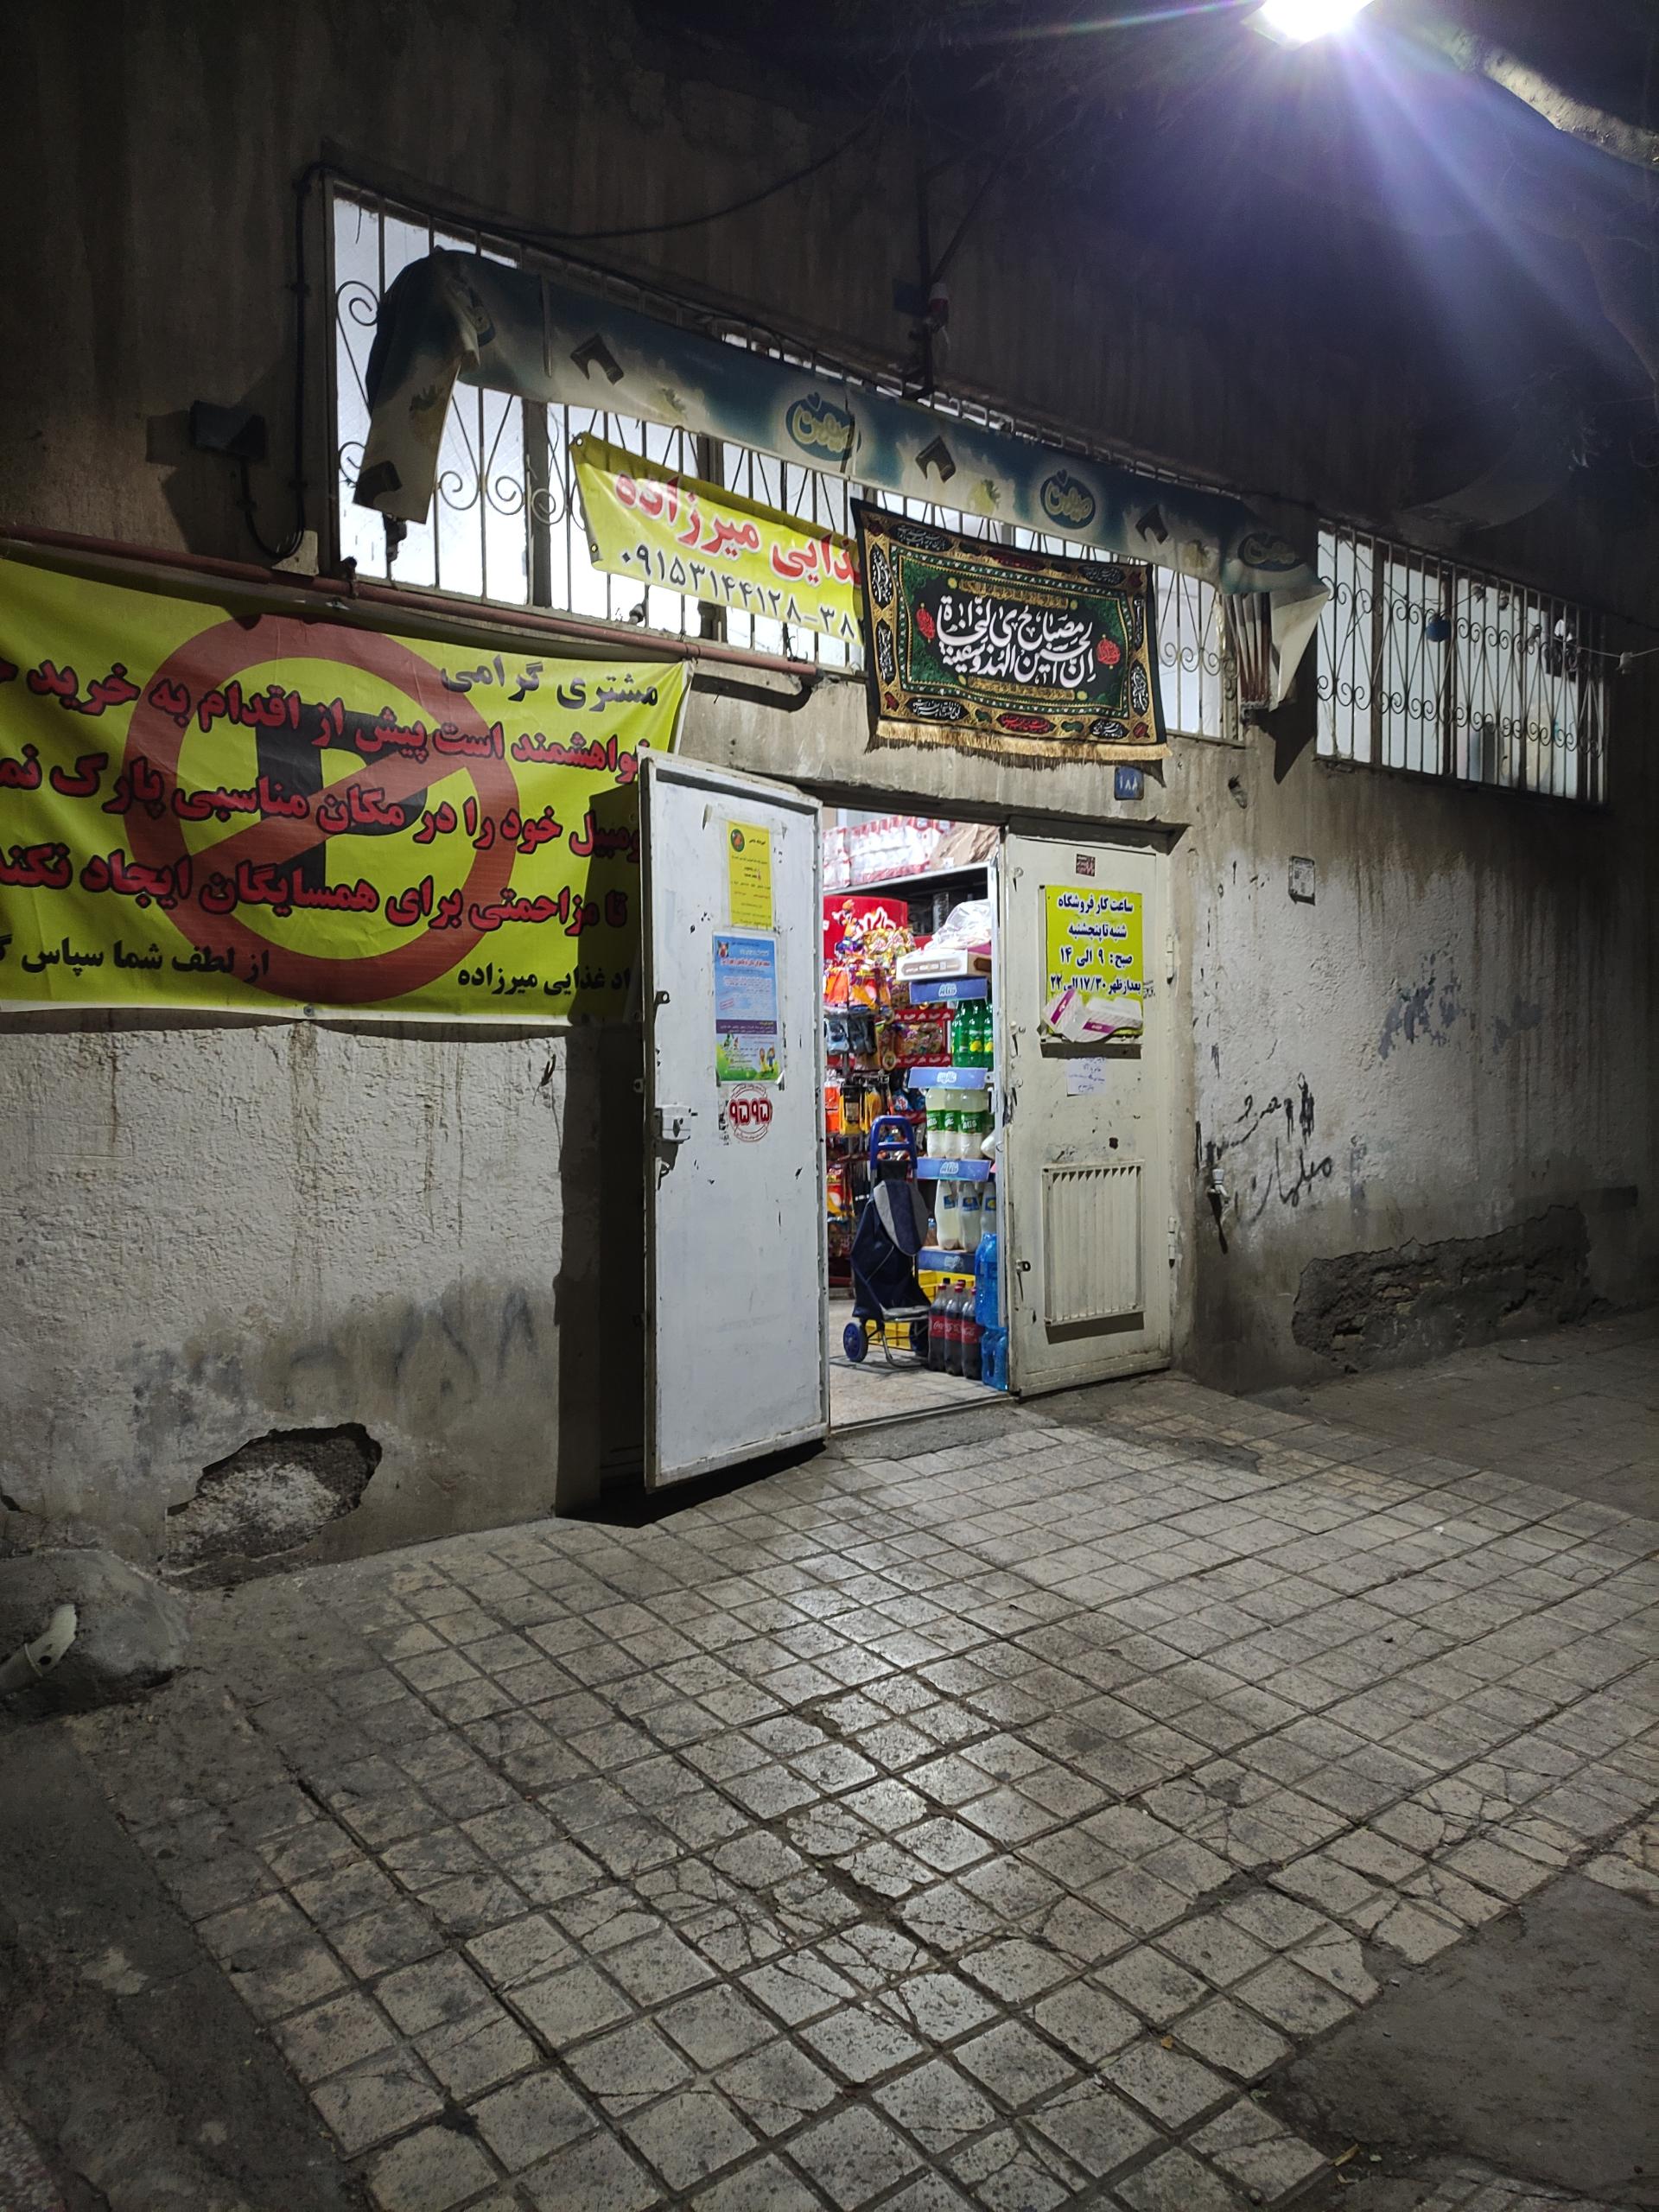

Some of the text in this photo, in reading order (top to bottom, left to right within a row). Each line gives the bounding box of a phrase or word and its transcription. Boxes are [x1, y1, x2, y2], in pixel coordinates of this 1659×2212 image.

[615, 473, 760, 560] میرزاده
[772, 531, 861, 587] ذایی
[26, 658, 142, 717] خرید
[148, 677, 191, 728] به
[197, 679, 302, 734] اقدام
[441, 654, 658, 712] مشتری گرامی
[311, 696, 345, 748] از
[354, 705, 429, 765] پیش
[432, 720, 505, 761] است
[511, 731, 651, 785] واهشمند
[49, 751, 167, 820] پارک
[173, 776, 311, 822] مناسبی
[315, 782, 406, 835] مکان
[412, 800, 458, 844] در
[461, 794, 497, 851] را
[499, 804, 564, 855] خود
[79, 847, 194, 909] ایجاد
[198, 858, 381, 918] همسایگان
[385, 874, 464, 931] برای
[467, 885, 601, 938] مزاحمتی
[604, 888, 629, 929] تا
[1058, 893, 1134, 915] ساعت کار فروشگاه
[21, 937, 105, 977] سپاس
[112, 939, 163, 970] شما
[1060, 946, 1072, 963] ۱۴
[1068, 922, 1128, 943] شنبه تا پنجشنبه
[1077, 948, 1093, 967] الی
[1097, 948, 1104, 964] ۹
[171, 944, 236, 975] لطف
[243, 949, 270, 984] از
[457, 962, 538, 996] میرزاده
[543, 965, 605, 996] غذایی
[728, 1098, 772, 1125] ۹۵۹۵
